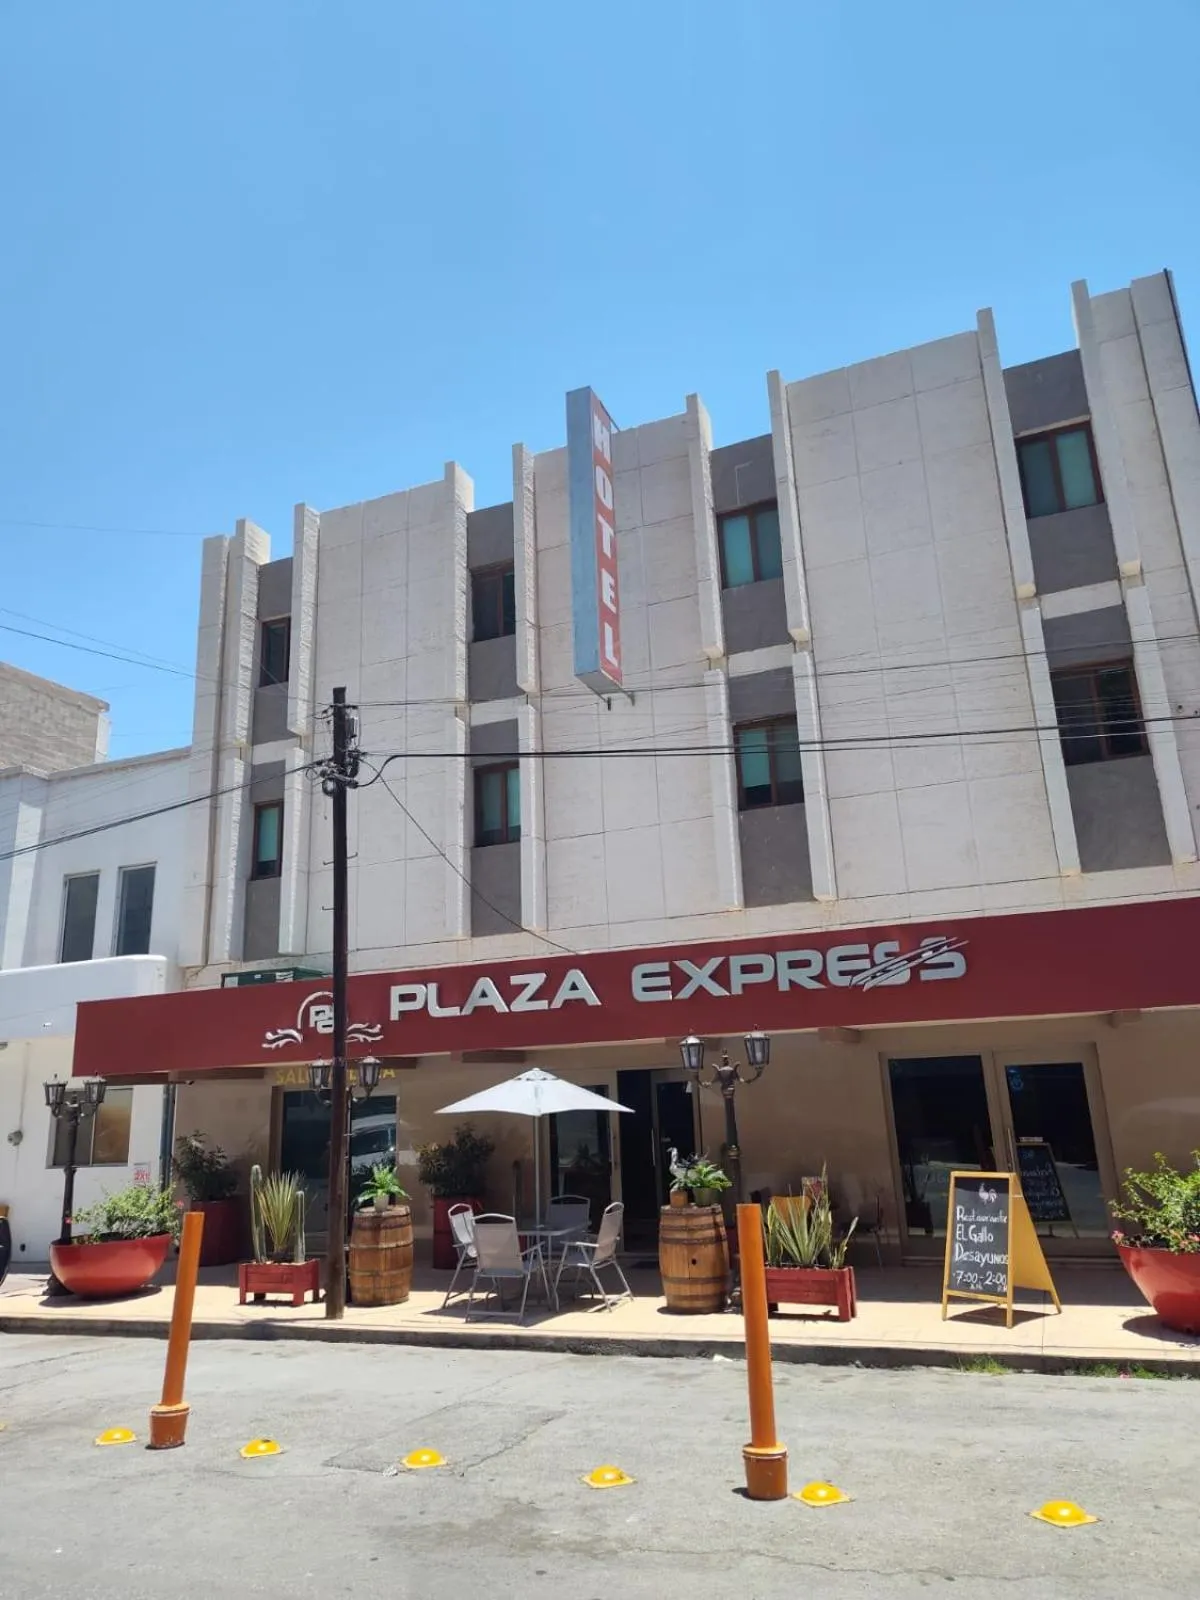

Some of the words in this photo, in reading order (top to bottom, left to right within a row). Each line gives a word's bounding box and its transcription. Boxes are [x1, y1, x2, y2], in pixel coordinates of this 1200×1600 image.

[592, 411, 618, 668] HOTEL
[389, 968, 602, 1021] PLAZA
[631, 936, 968, 1002] EXPRESS
[956, 1205, 1008, 1223] Restaurante
[968, 1224, 994, 1244] Gallo
